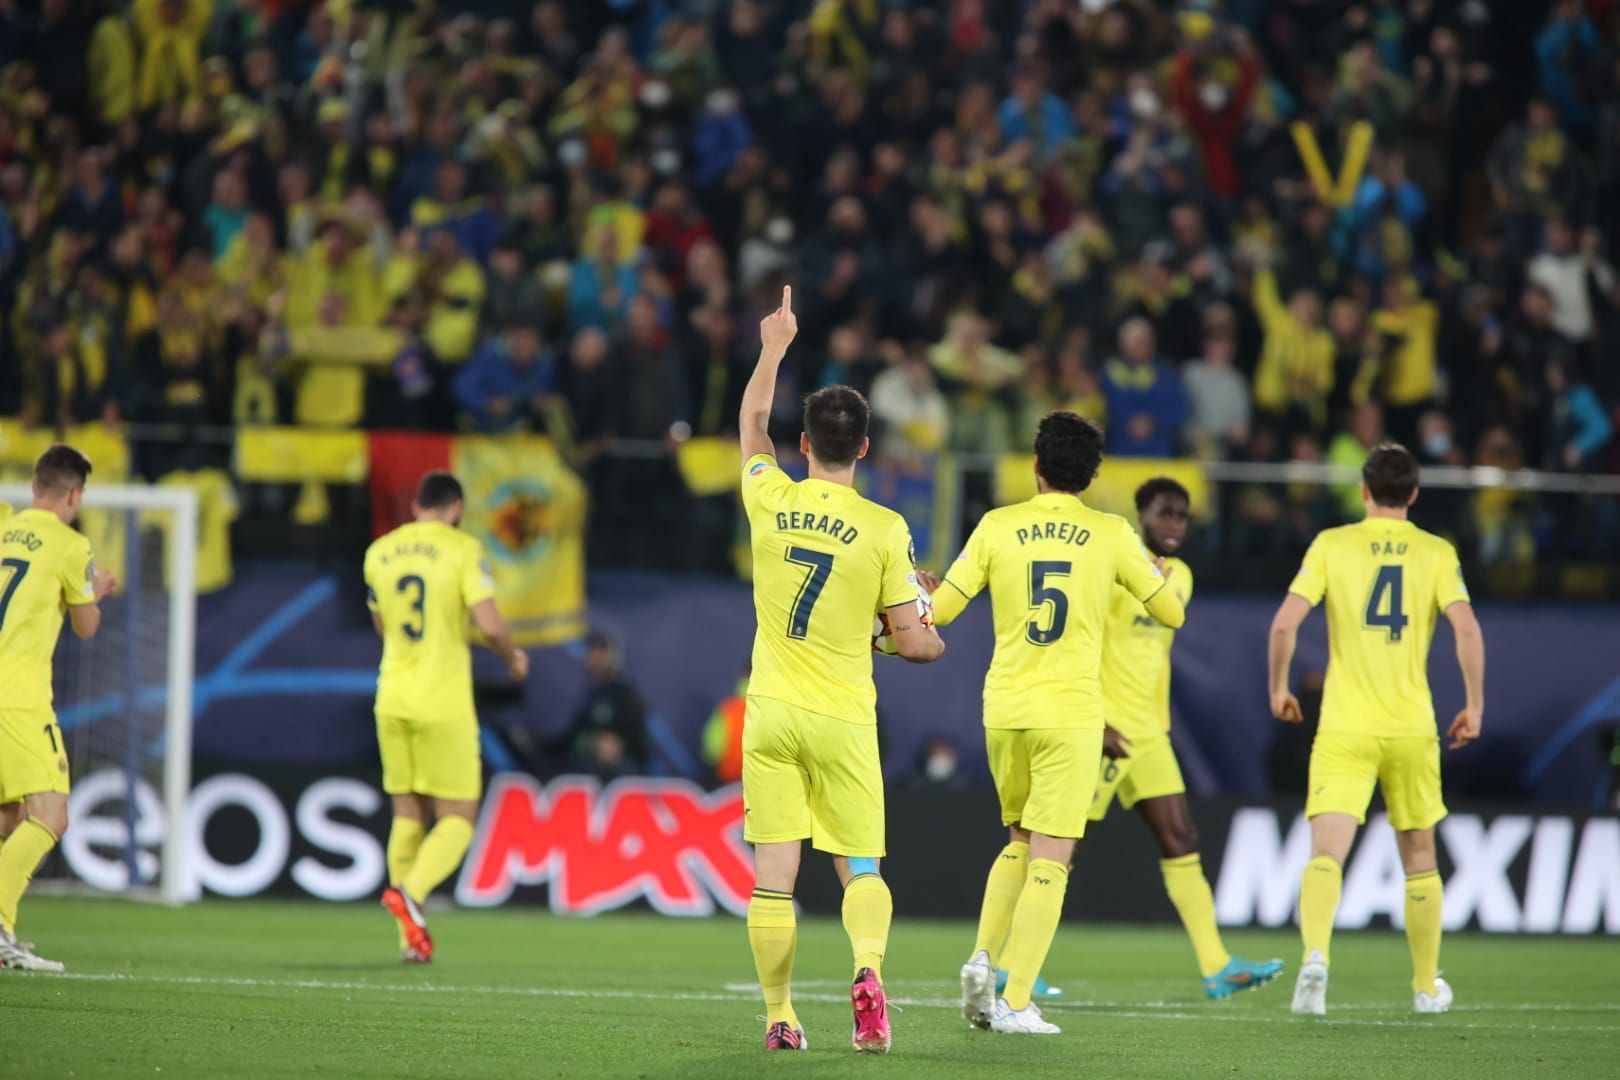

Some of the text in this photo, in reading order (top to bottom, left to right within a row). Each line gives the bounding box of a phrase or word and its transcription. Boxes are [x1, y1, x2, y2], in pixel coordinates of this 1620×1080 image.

[3, 529, 42, 552] CELSO
[776, 511, 858, 545] GERARD
[1016, 522, 1090, 546] PAREJO
[1371, 541, 1408, 555] PAU
[397, 573, 426, 642] 3
[784, 545, 834, 640] 7
[1025, 560, 1072, 647] 5
[1361, 564, 1408, 644] 4
[455, 772, 800, 917] MAX
